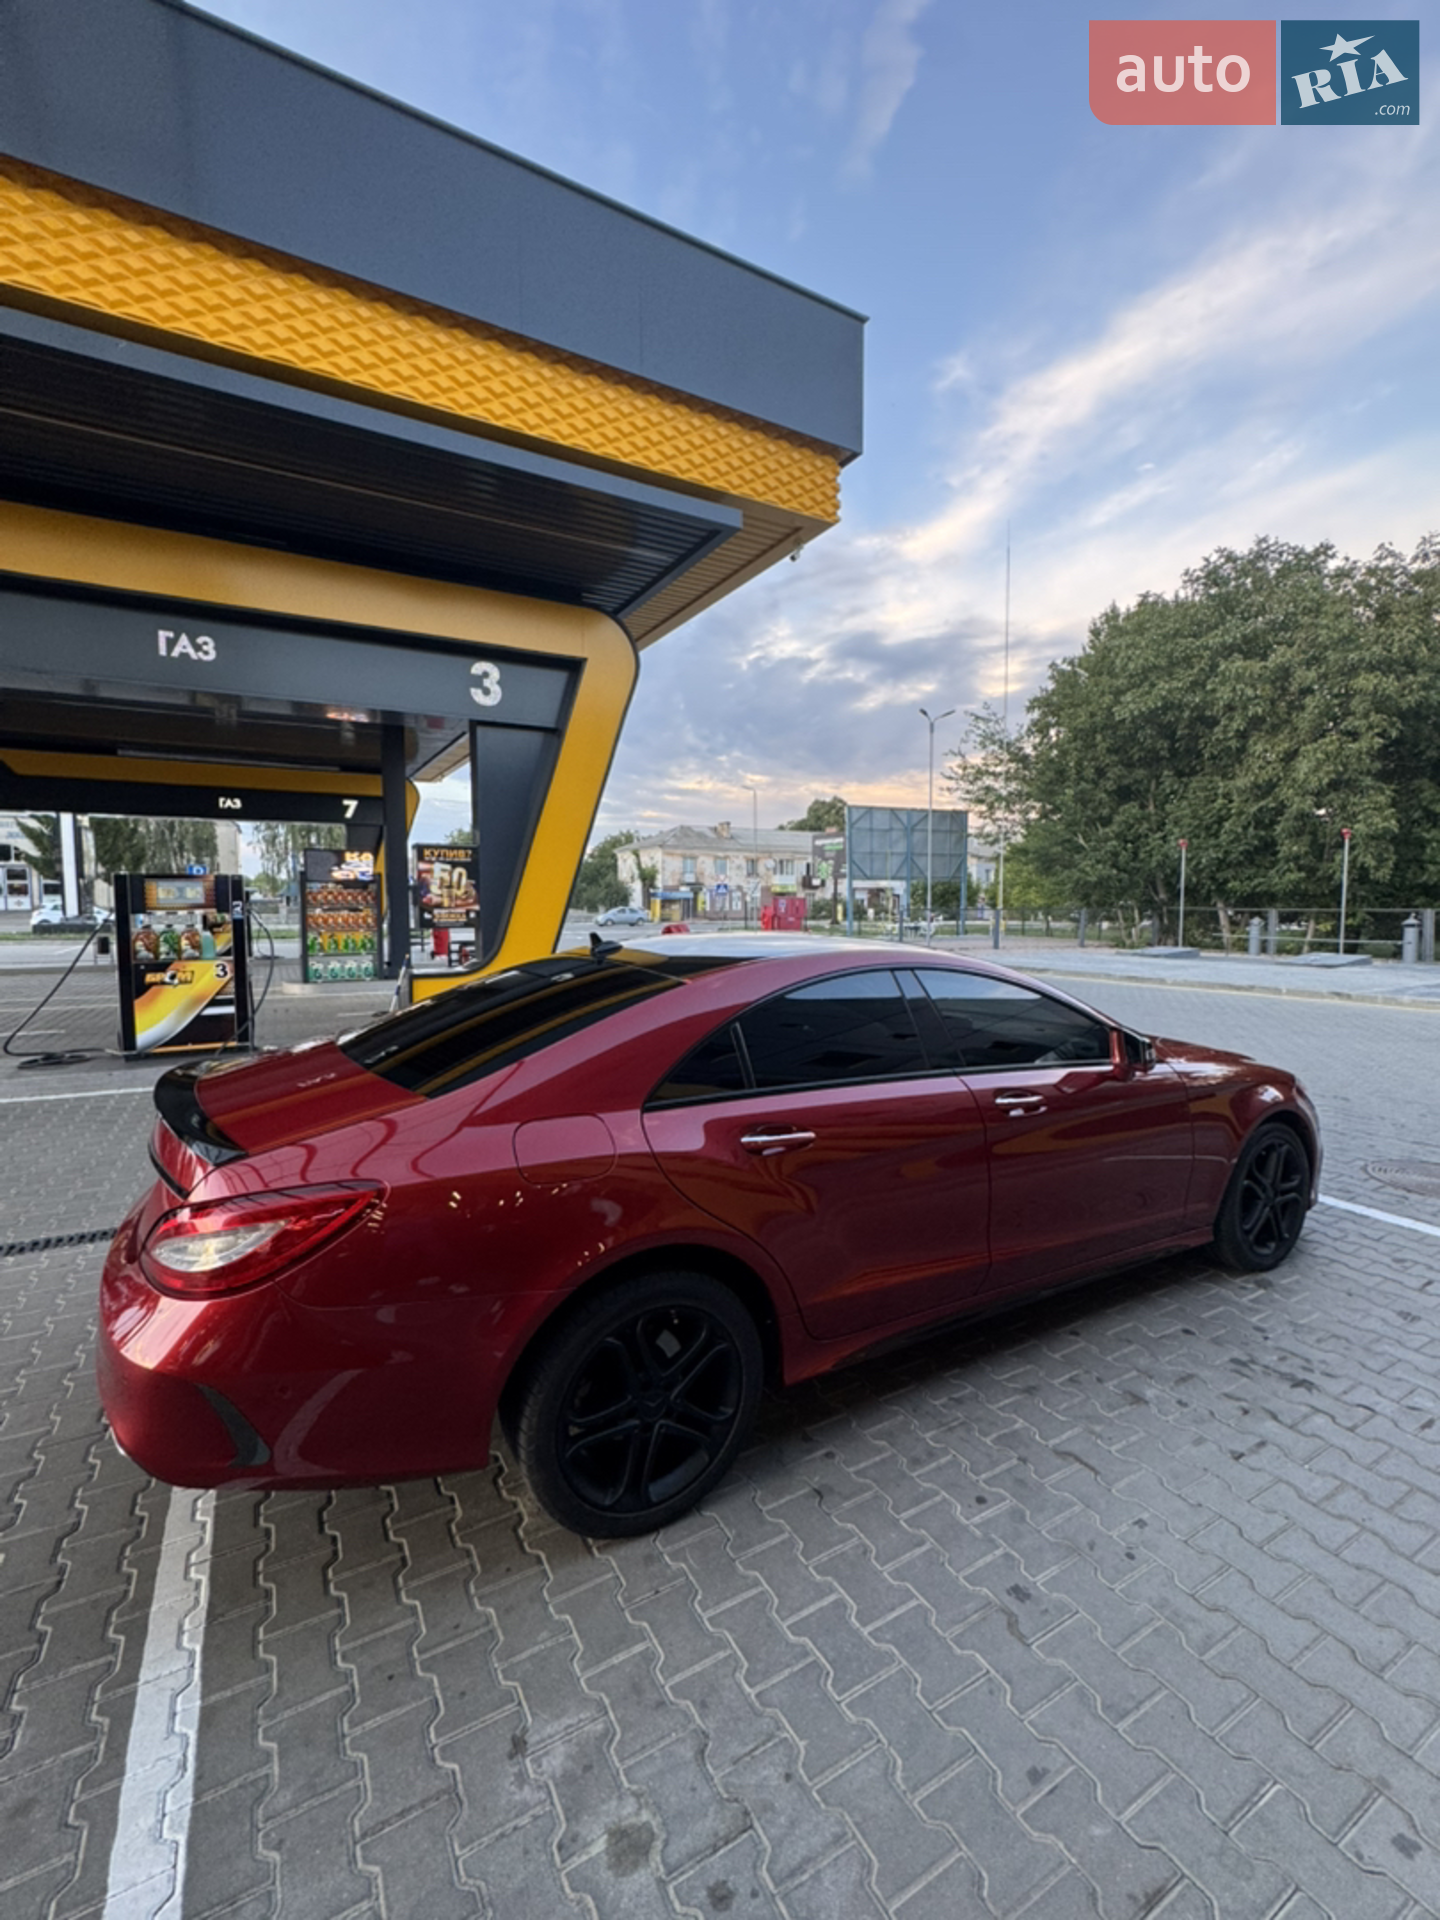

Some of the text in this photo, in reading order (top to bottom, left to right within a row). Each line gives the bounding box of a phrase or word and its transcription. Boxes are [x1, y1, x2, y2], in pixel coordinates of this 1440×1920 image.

[157, 629, 217, 662] ГАЗ
[470, 661, 503, 707] 3
[218, 797, 242, 809] ГАЗ
[342, 800, 358, 819] 7
[214, 963, 229, 979] 3
